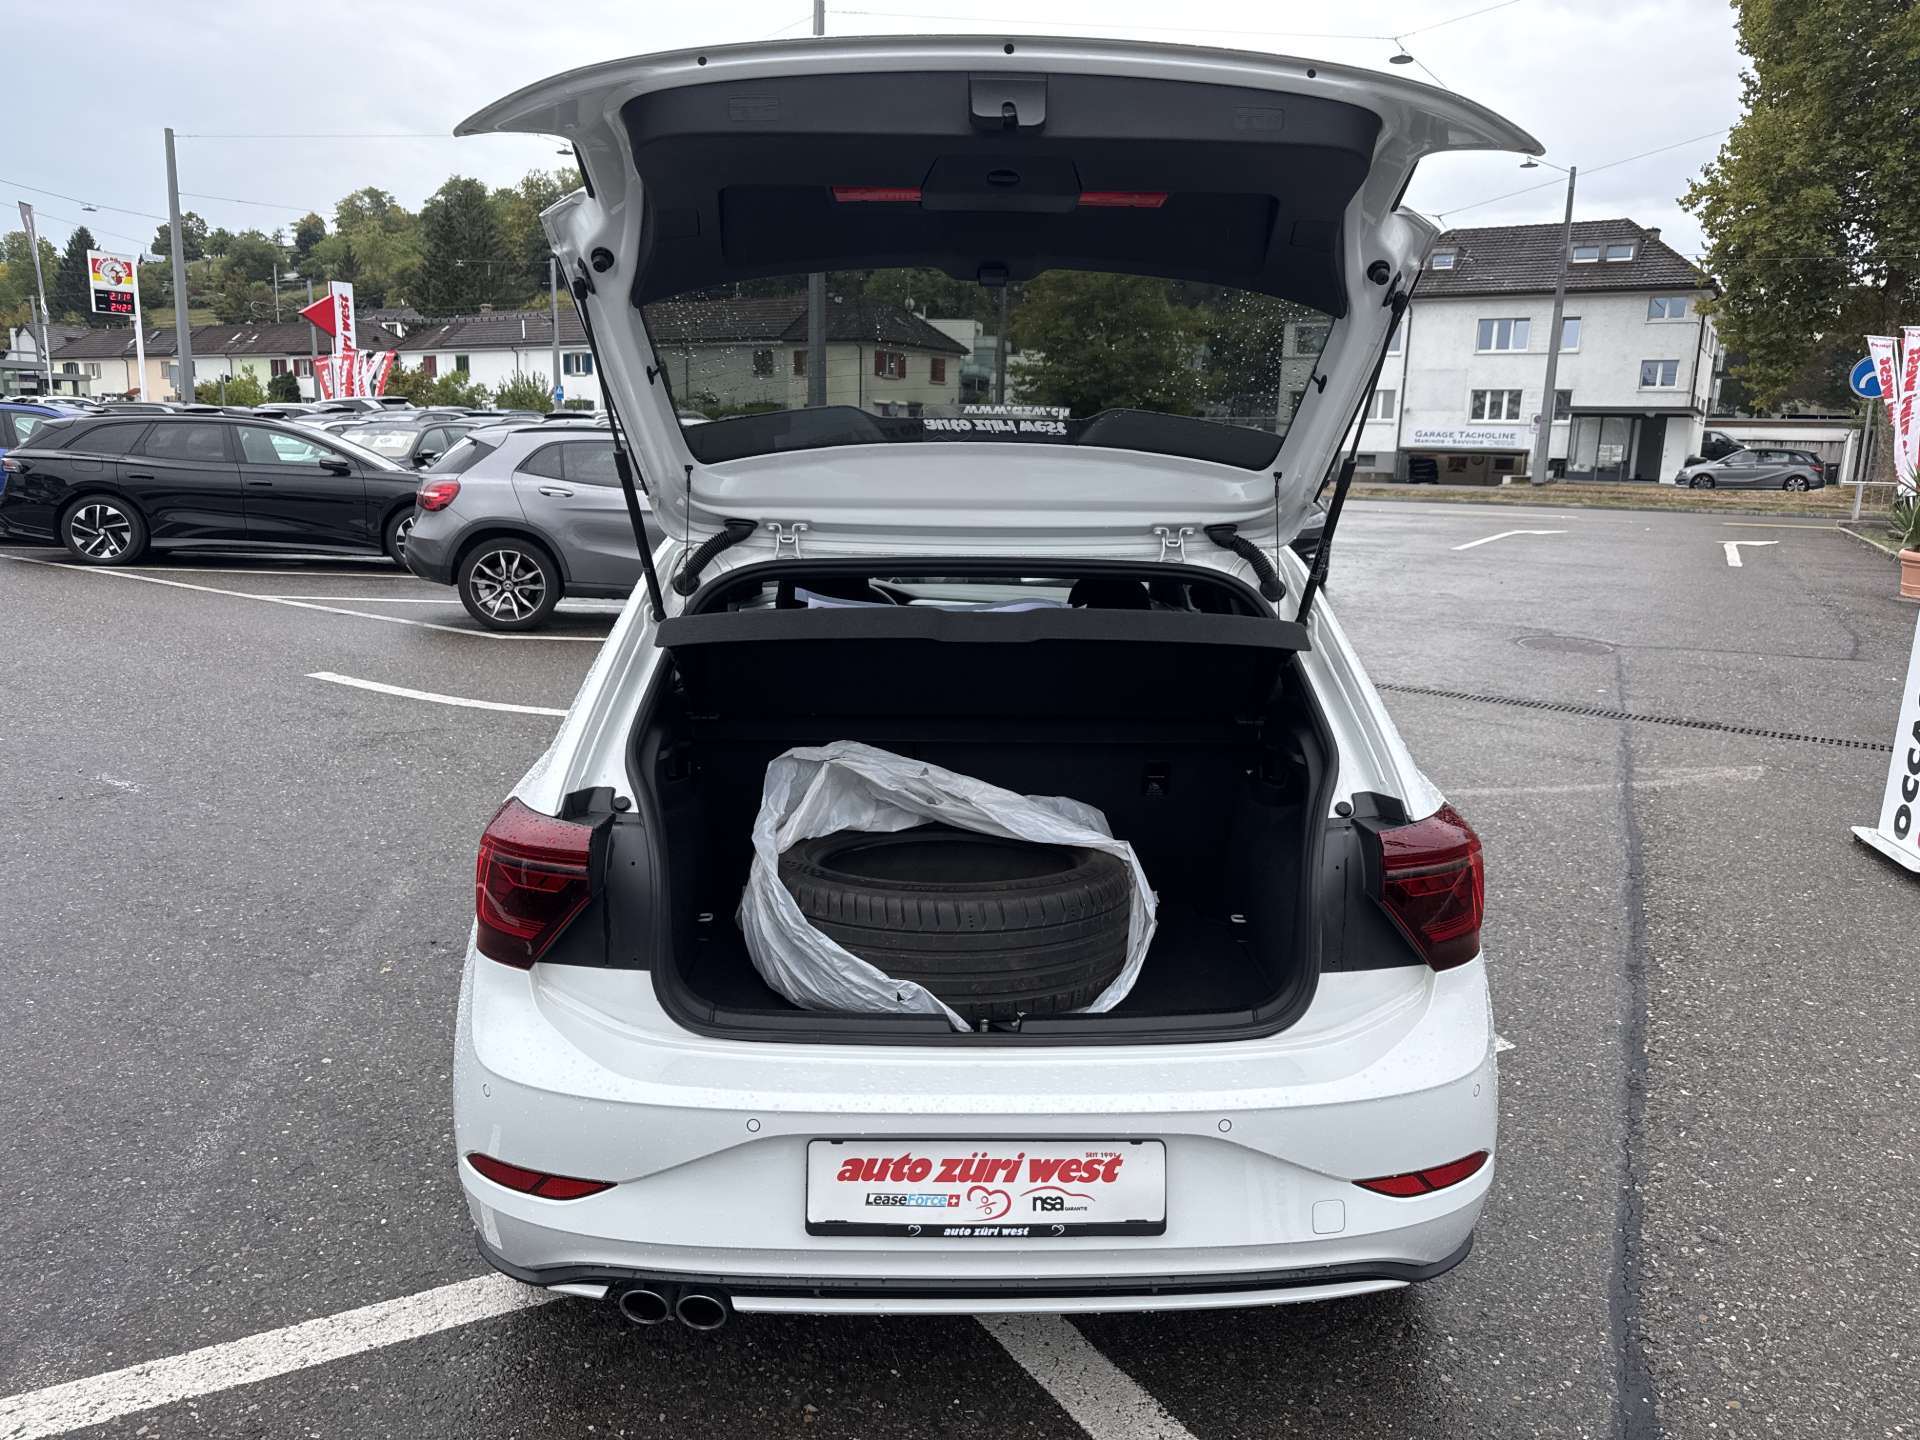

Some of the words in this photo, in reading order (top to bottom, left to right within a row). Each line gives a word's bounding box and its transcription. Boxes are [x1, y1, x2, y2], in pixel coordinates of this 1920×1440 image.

[339, 293, 351, 332] west
[1415, 430, 1455, 438] GARAGE
[1894, 694, 1920, 841] OCCA
[836, 1152, 933, 1183] auto
[933, 1152, 1026, 1183] züri
[1029, 1153, 1124, 1184] west
[865, 1193, 947, 1207] LeaseForce
[1032, 1196, 1064, 1211] nsa
[943, 1226, 971, 1236] auto
[973, 1226, 1000, 1236] züri
[1002, 1226, 1029, 1236] west
